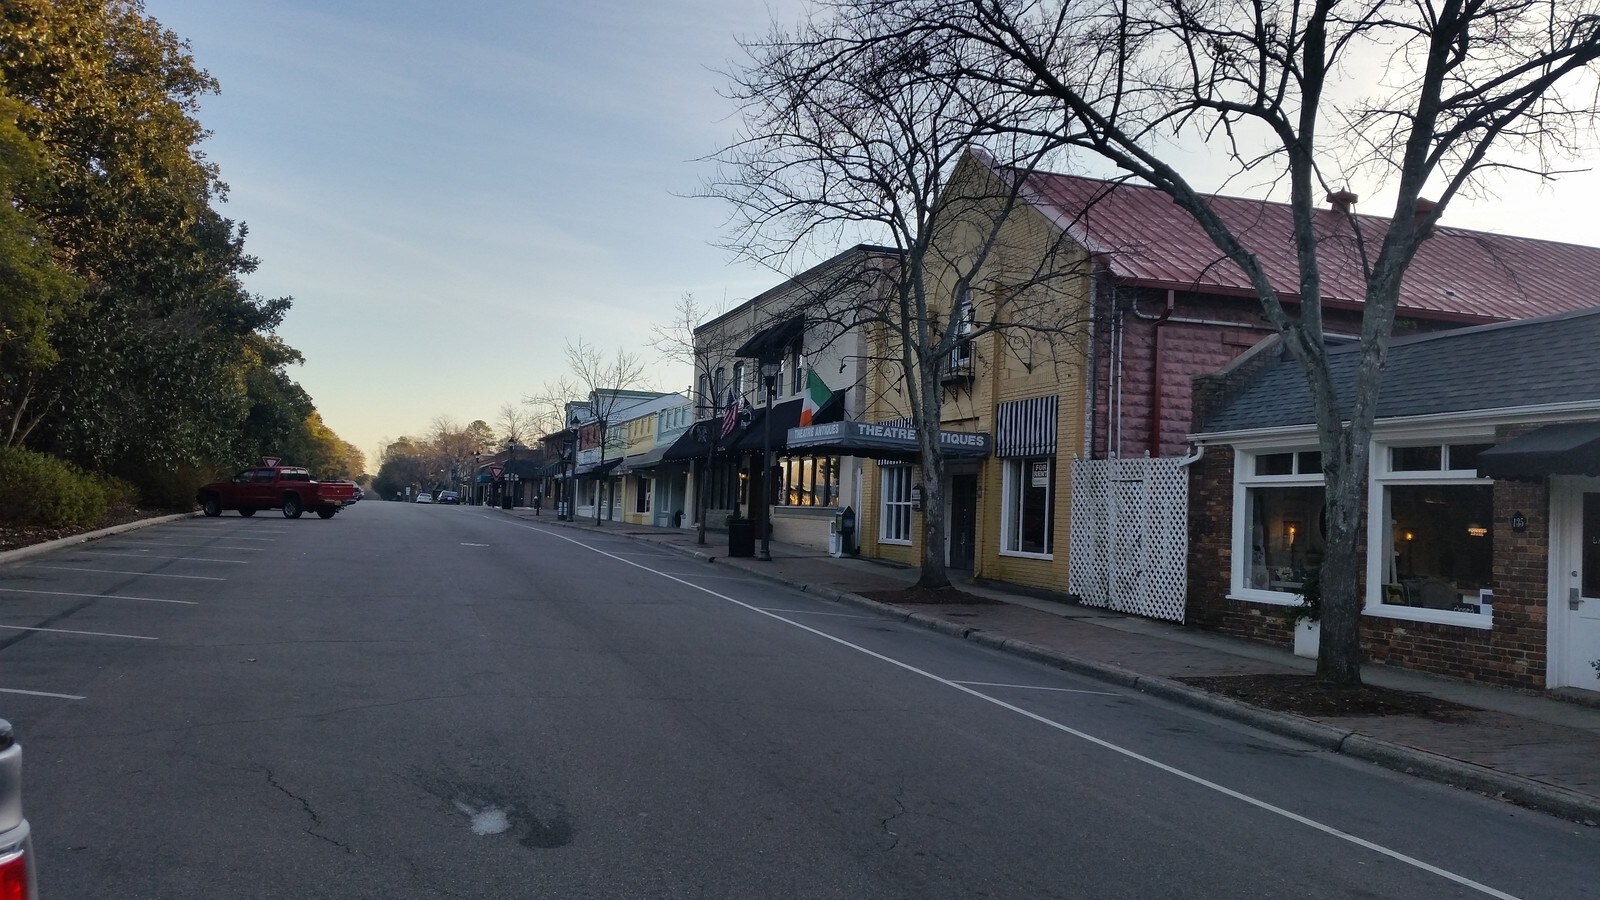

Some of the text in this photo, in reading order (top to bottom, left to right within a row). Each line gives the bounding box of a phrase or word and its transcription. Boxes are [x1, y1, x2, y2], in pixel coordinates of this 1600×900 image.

[794, 423, 839, 439] THEATRE ANTIQUES
[857, 424, 985, 447] THEATRE TIQUES
